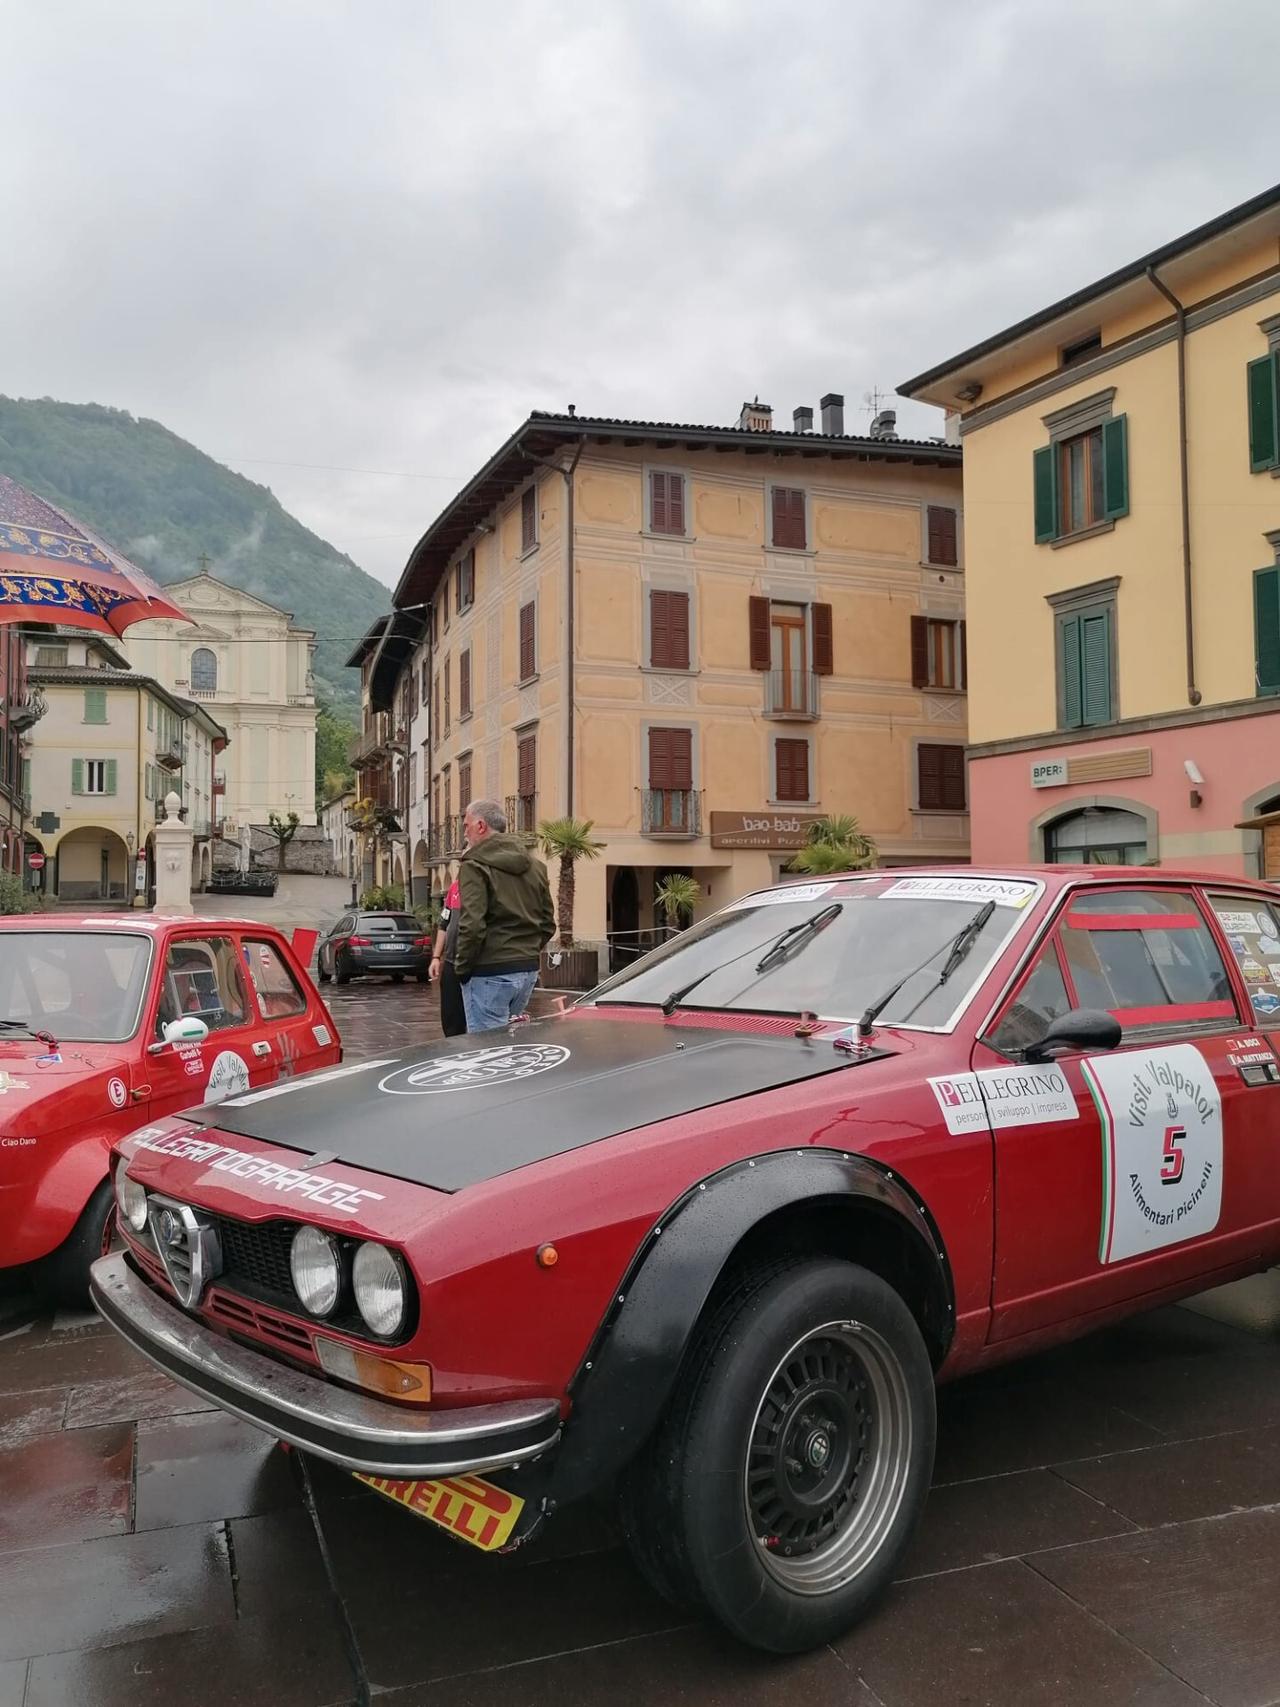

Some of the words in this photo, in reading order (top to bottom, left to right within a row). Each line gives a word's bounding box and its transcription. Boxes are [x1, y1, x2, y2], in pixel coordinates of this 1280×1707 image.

[742, 816, 770, 832] bao
[773, 816, 801, 833] bab
[895, 879, 1026, 896] PELLEGRINO
[227, 1055, 248, 1091] Valpalo
[935, 1073, 1065, 1108] PELLEGRINO
[997, 1105, 1031, 1119] sviluppo
[1037, 1101, 1069, 1114] impresa
[1129, 1073, 1151, 1128] Visit
[1145, 1060, 1214, 1125] Valpalot
[1, 1138, 19, 1147] Ciao
[1160, 1125, 1187, 1186] 5
[1129, 1172, 1175, 1226] Alimentari
[1176, 1160, 1213, 1222] Picinelli
[358, 1473, 502, 1547] RELLI
